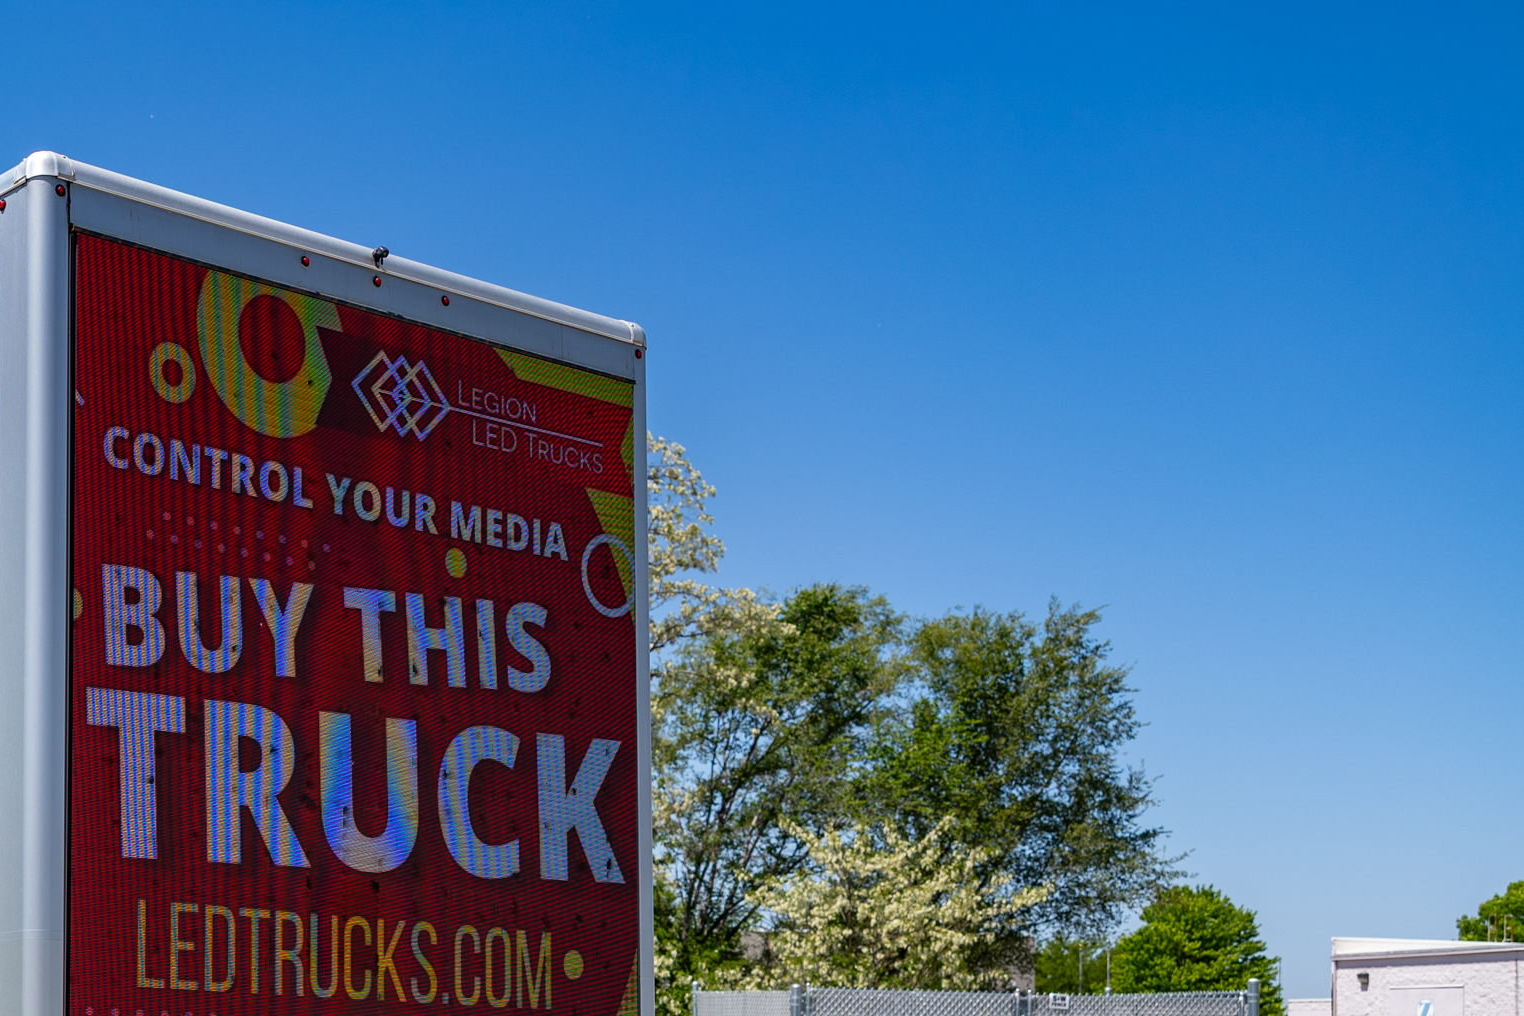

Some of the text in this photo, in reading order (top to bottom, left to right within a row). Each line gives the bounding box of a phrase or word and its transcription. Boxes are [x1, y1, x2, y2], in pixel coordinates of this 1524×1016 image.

[458, 380, 536, 424] LEGION
[472, 419, 603, 474] LED TRUCKS
[103, 425, 569, 562] CONTROL YOUR MEDIA
[102, 563, 552, 694] BUY THIS
[86, 686, 627, 884] TRUCK
[137, 898, 553, 1010] LEDTRUCKS.COM
